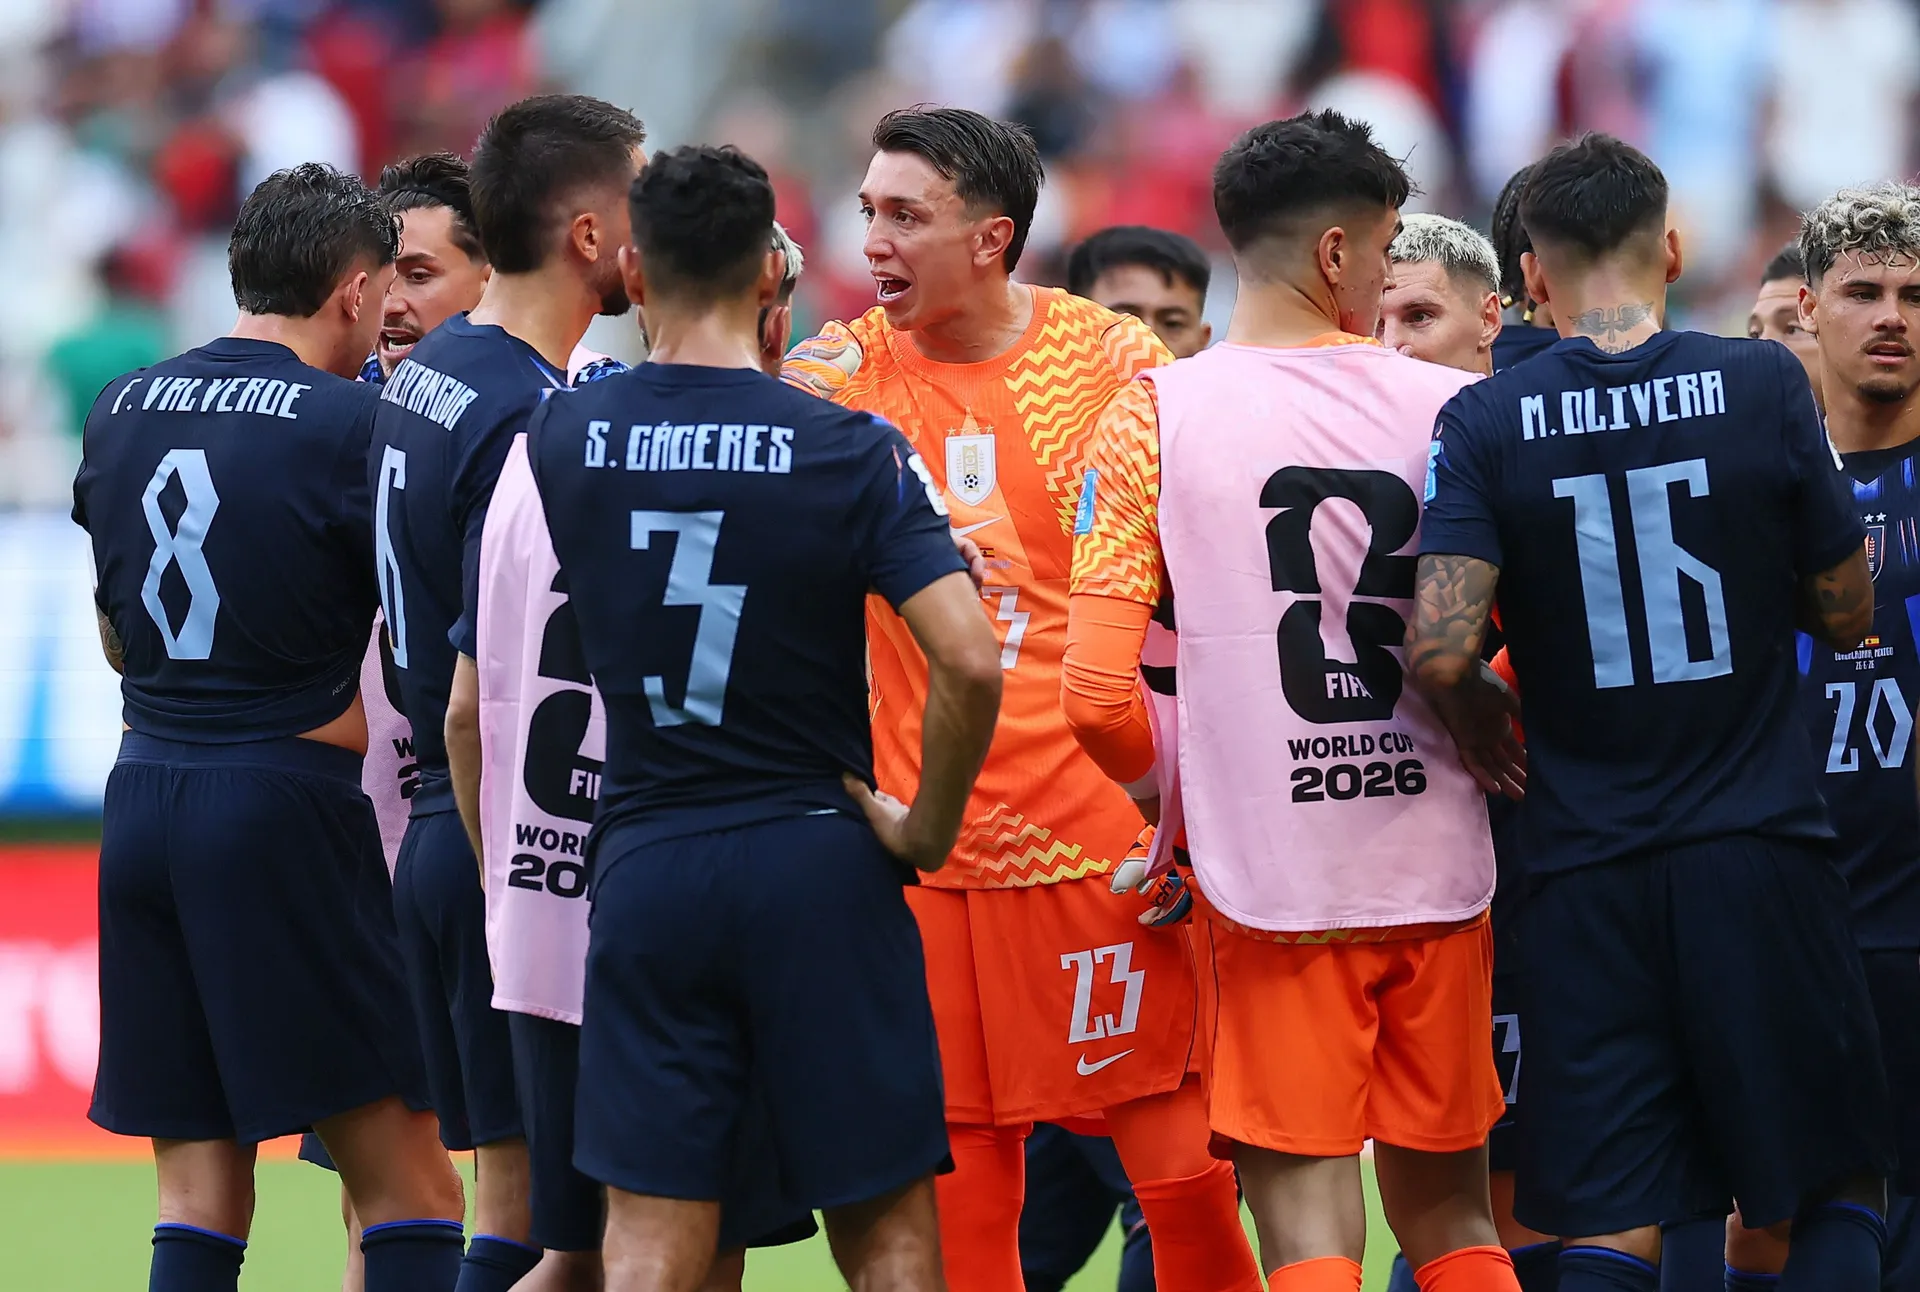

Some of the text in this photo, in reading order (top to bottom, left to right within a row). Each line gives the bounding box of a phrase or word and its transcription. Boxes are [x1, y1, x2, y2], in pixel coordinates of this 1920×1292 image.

[111, 376, 312, 420] F. VALVERDE
[1520, 370, 1726, 441] M. OLIVERA
[585, 420, 618, 468] S.
[142, 449, 220, 660] 8
[1552, 458, 1733, 689] 16
[1287, 731, 1415, 761] WORLD CUP
[1825, 678, 1914, 774] 20
[569, 768, 602, 801] FI
[1290, 759, 1427, 803] 2026
[516, 823, 588, 857] WOR
[508, 853, 591, 902] 20
[1060, 941, 1146, 1044] 23
